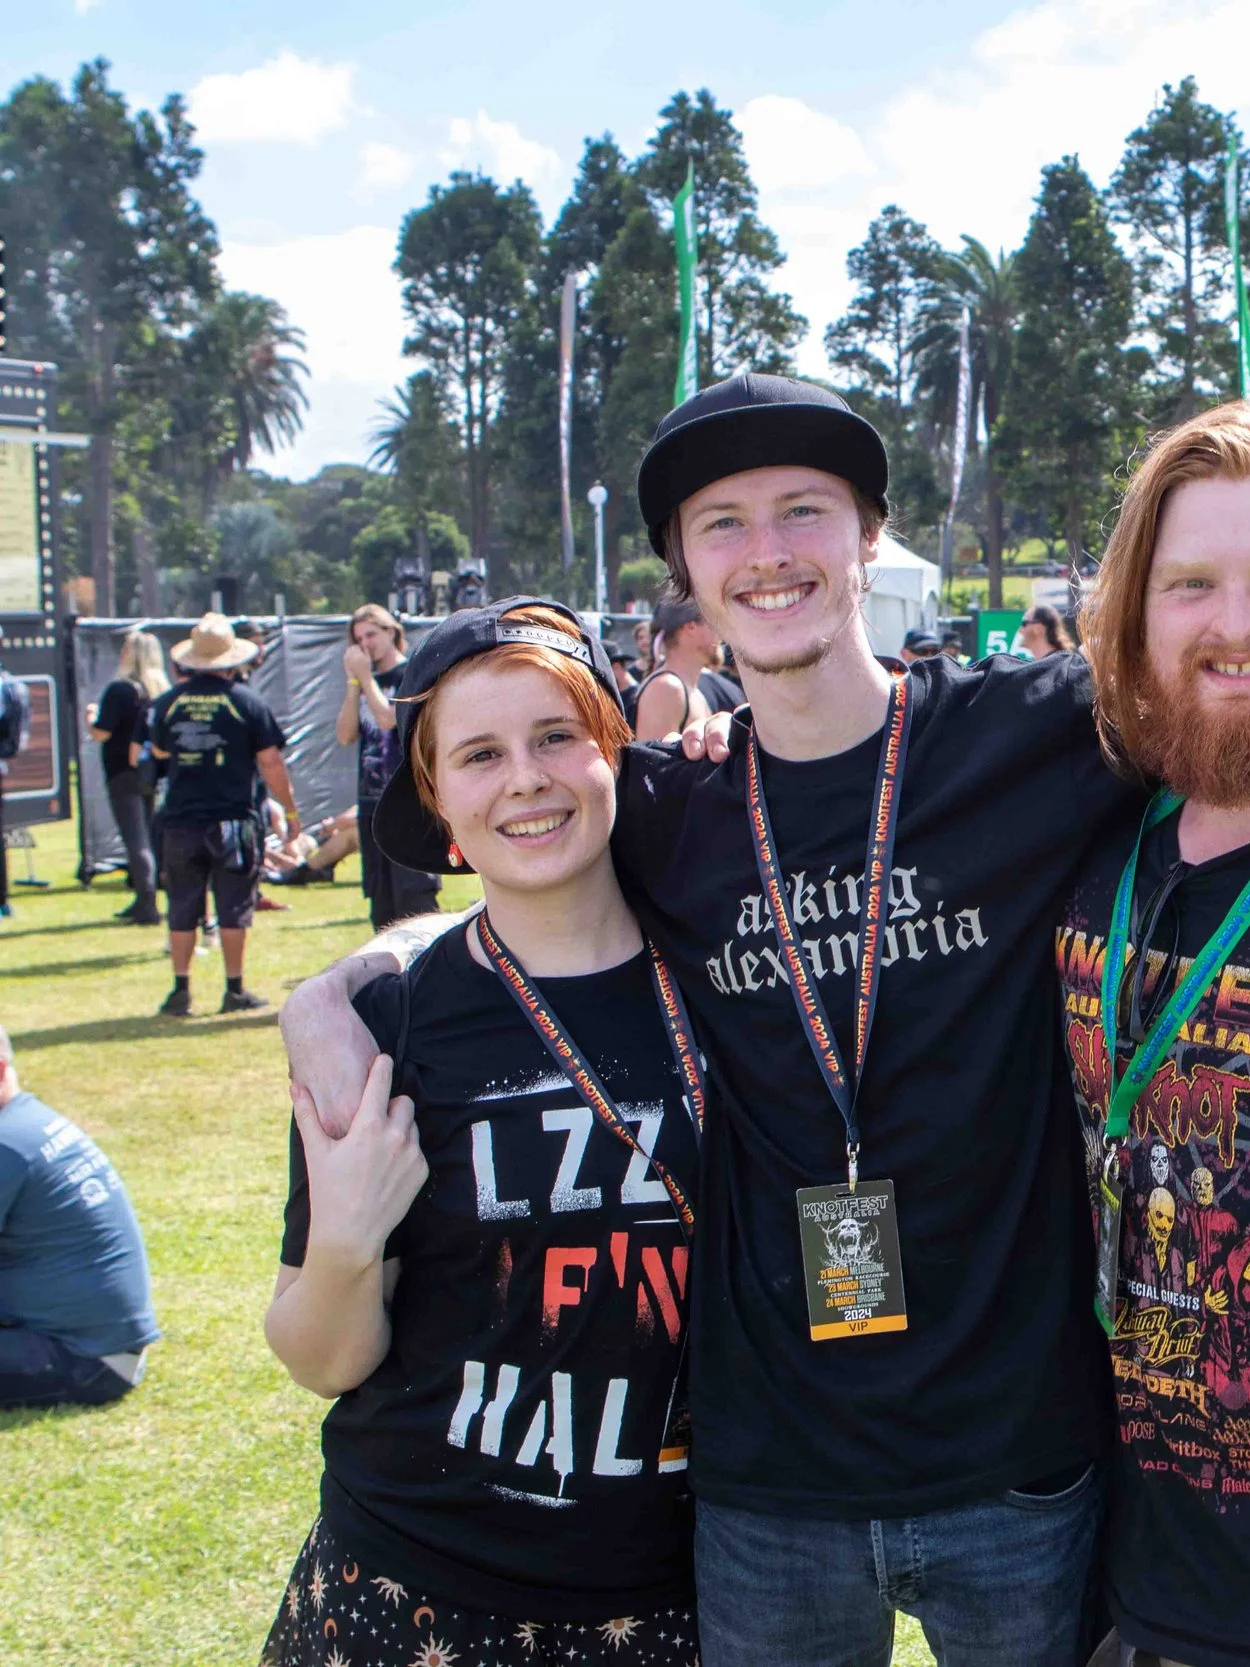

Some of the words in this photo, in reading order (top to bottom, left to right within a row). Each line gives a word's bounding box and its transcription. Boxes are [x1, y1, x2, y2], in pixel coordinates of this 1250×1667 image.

[884, 711, 906, 776] AUSTRALIA
[752, 807, 767, 840] 2024
[875, 778, 894, 841] KNOTFEST
[759, 841, 772, 862] VIP
[870, 860, 882, 883] VIP
[867, 885, 881, 920] 2024
[766, 878, 795, 941] KNOTFEST
[785, 945, 817, 1014] AUSTRALIA
[808, 1015, 830, 1050] 2024
[822, 1050, 840, 1073] VIP
[860, 923, 878, 996] AUSTRALIA
[655, 960, 679, 1018] KNOTFEST
[1175, 948, 1222, 1014] AUSTRALIA
[497, 957, 539, 1012] AUSTRALIA
[534, 1010, 559, 1040] 2024
[555, 1037, 573, 1058] VIP
[675, 1032, 689, 1053] VIP
[856, 999, 870, 1064] KNOTFEST
[681, 1053, 700, 1087] 2024
[574, 1069, 617, 1124] KNOTFEST
[471, 1100, 692, 1221] LZZ
[682, 1204, 695, 1224] VIP
[803, 1195, 889, 1218] KNOTFEST
[814, 1208, 880, 1222] AUSTRALIA
[827, 1267, 849, 1279] MARCH
[849, 1262, 885, 1276] MELBOURNE
[828, 1283, 837, 1293] 23
[837, 1280, 859, 1292] MARCH
[859, 1278, 882, 1289] SYDNEY
[826, 1297, 834, 1308] 24
[834, 1295, 857, 1307] MARCH
[856, 1292, 886, 1304] BRISBANE
[1127, 1279, 1160, 1300] PECIAL
[1161, 1289, 1200, 1310] GUESTS
[844, 1308, 872, 1321] 2024
[848, 1321, 868, 1332] VIP
[447, 1360, 666, 1480] HAL
